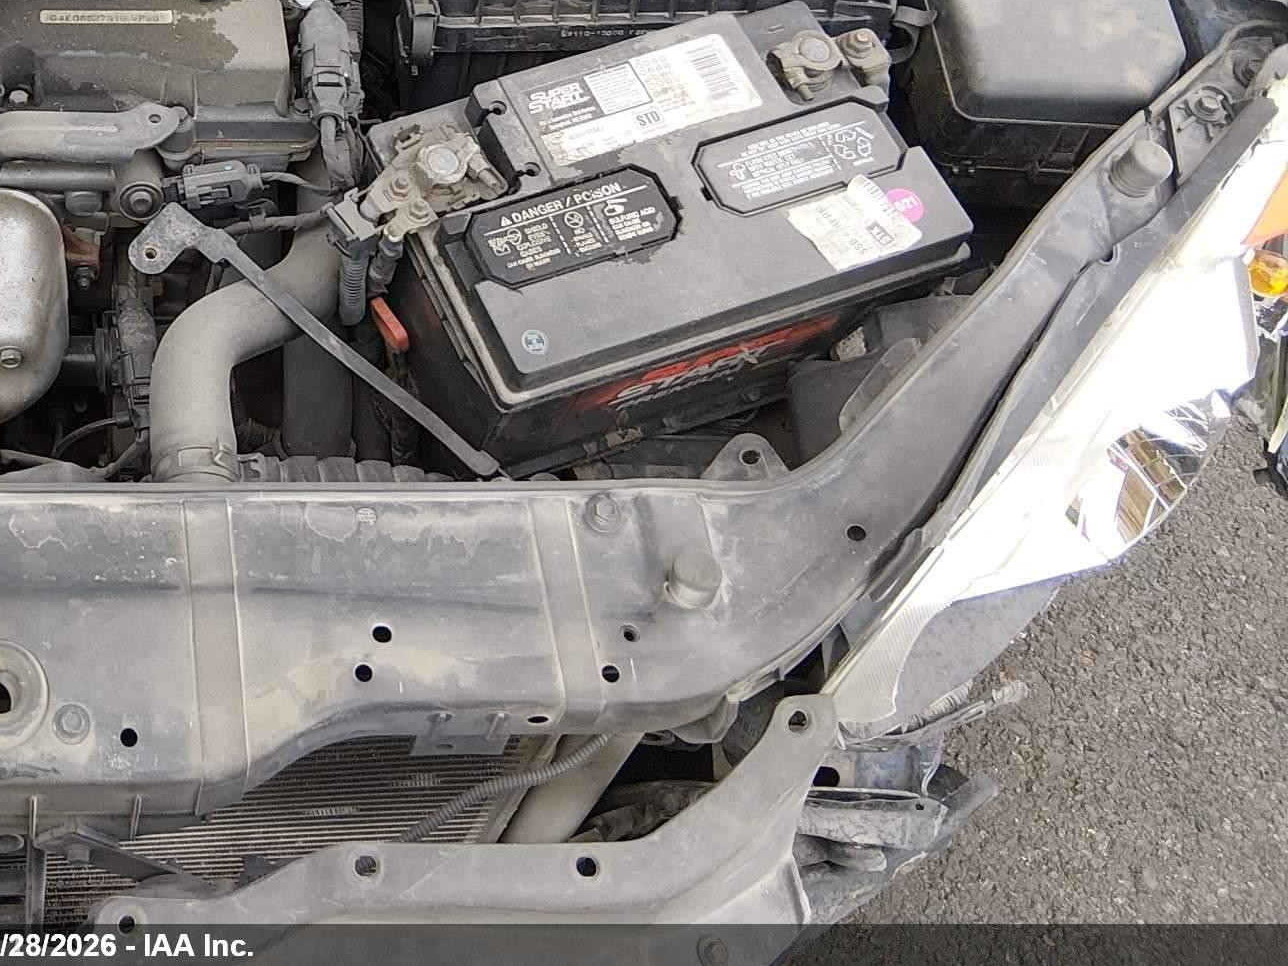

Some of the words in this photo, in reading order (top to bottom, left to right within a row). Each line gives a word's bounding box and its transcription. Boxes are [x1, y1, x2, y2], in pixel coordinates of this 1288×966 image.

[528, 90, 585, 114] START
[530, 82, 581, 103] SUPER
[635, 110, 662, 127] STD
[511, 199, 563, 225] DANGER
[573, 182, 622, 205] POISON
[608, 346, 770, 406] START
